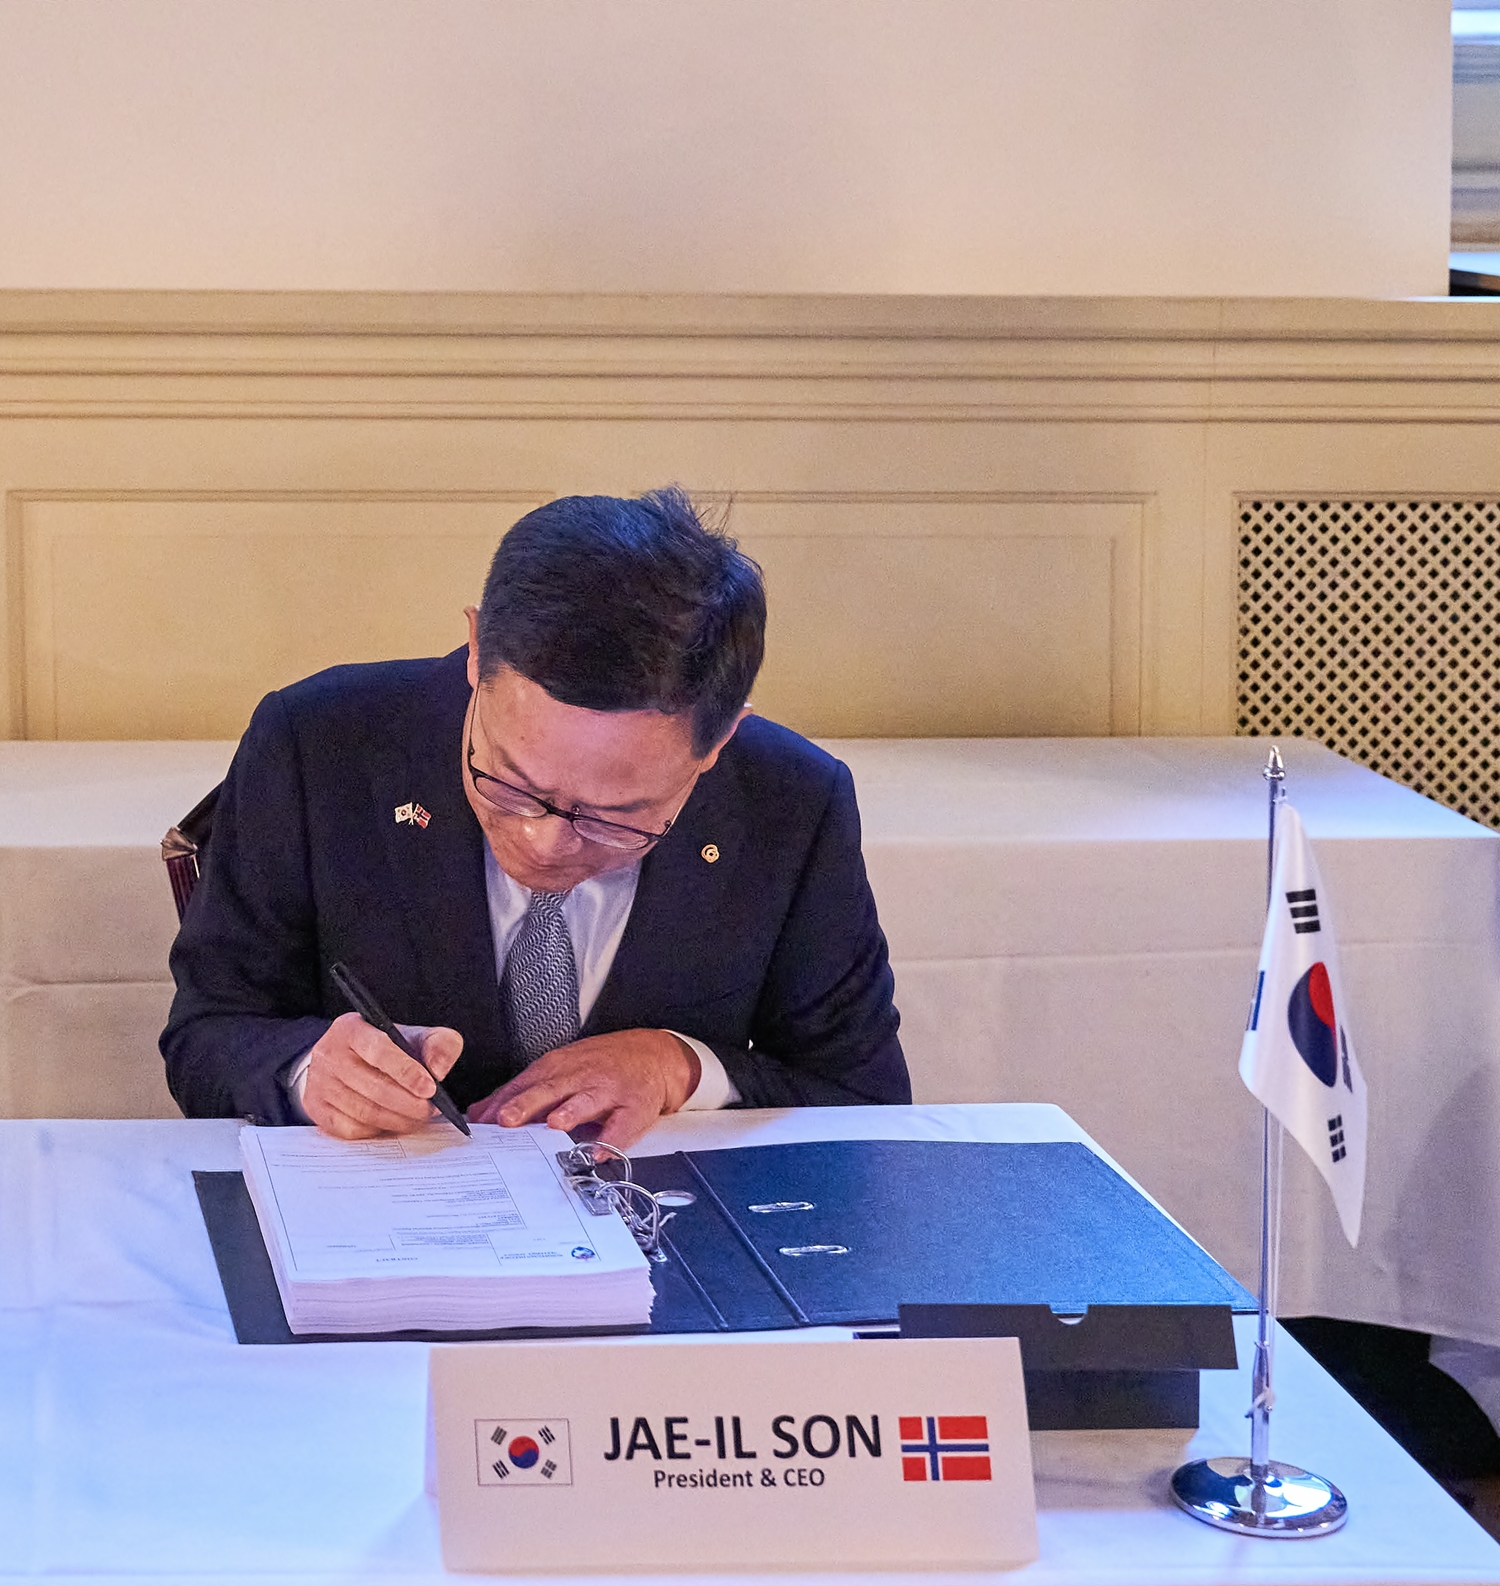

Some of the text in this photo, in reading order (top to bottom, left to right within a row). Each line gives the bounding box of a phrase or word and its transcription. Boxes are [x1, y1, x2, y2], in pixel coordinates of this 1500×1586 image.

[604, 1414, 882, 1460] JAE-IL SON
[654, 1468, 825, 1488] President & CEO
